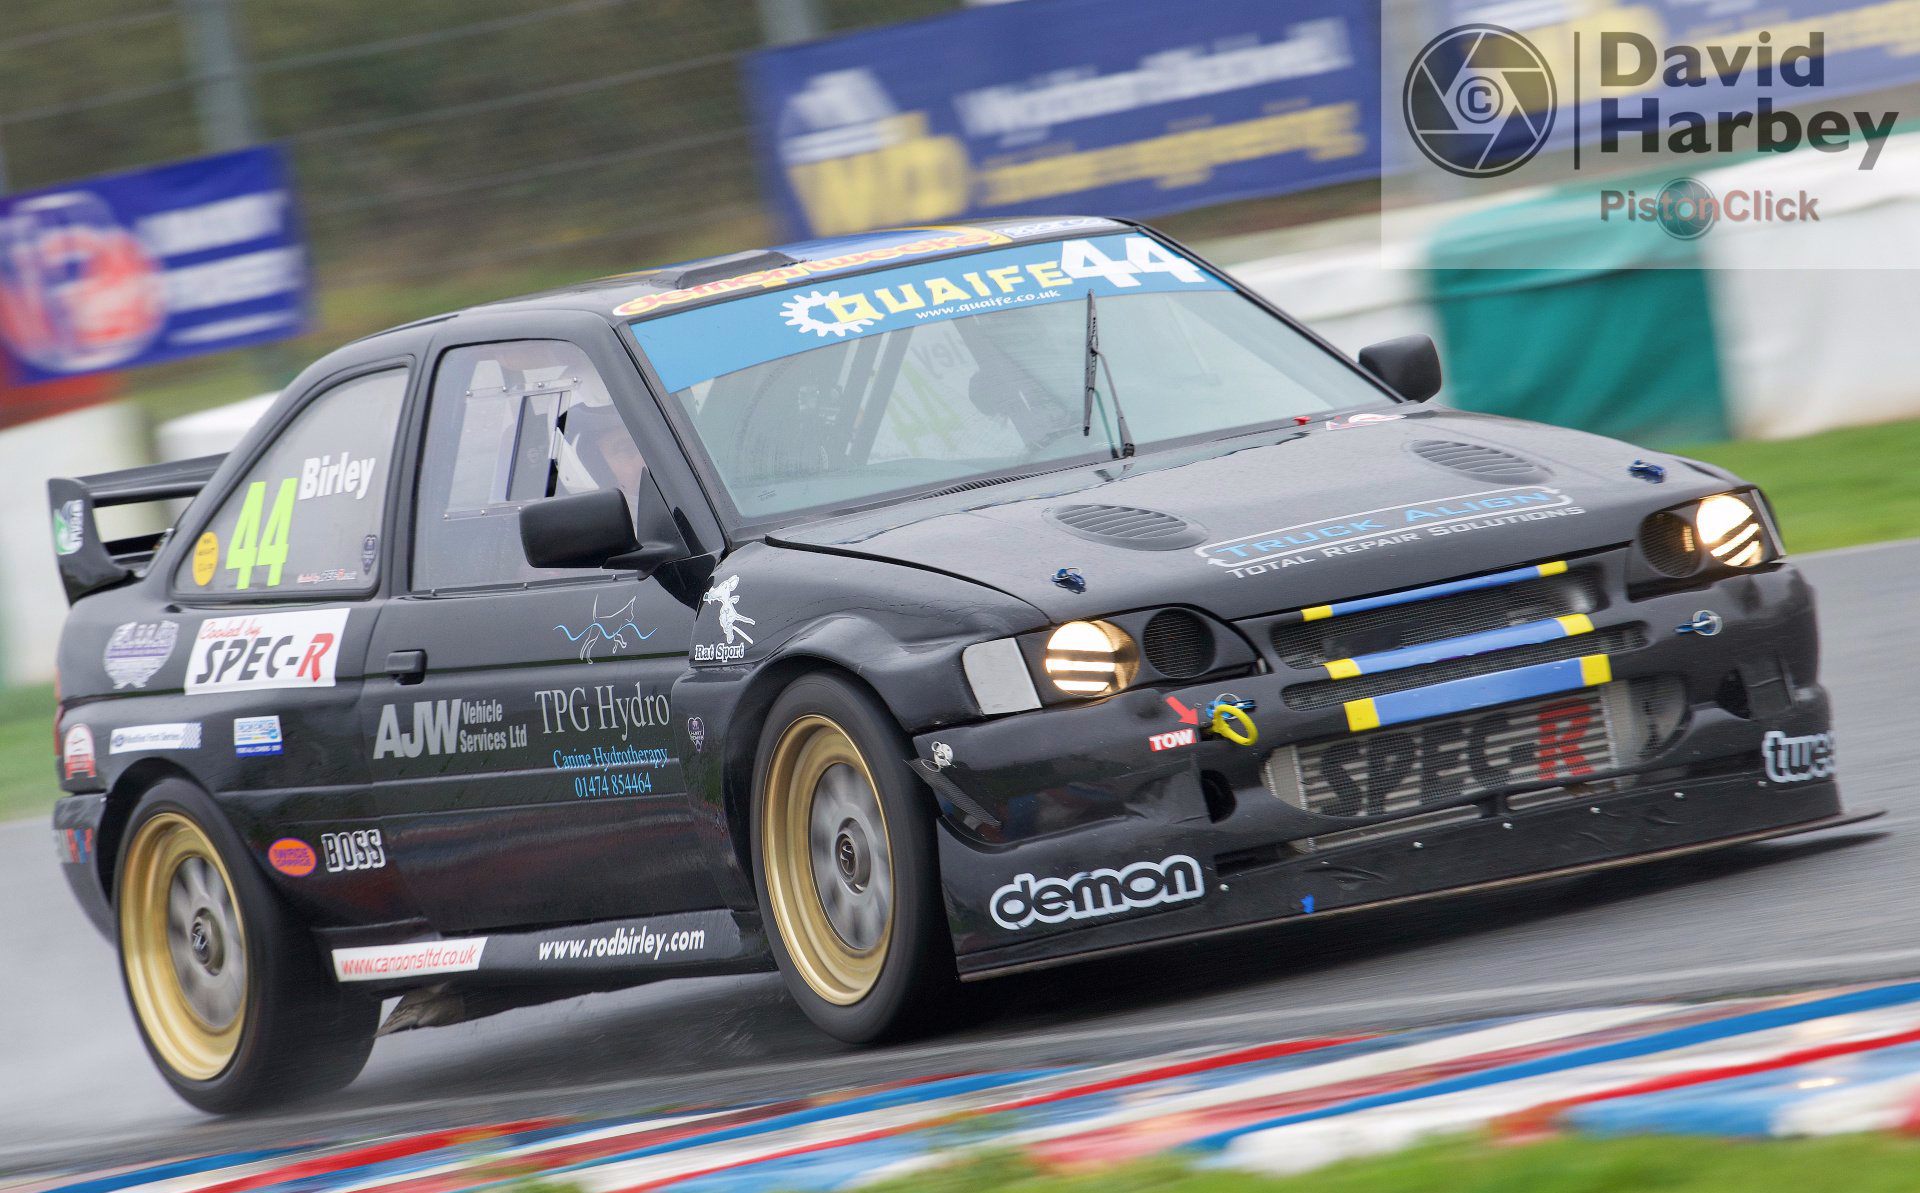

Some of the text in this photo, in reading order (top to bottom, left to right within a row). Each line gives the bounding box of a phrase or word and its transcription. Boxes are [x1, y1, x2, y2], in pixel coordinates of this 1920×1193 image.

[825, 237, 1207, 323] QUAIFE 44
[915, 289, 1061, 319] www.quaife.co.uk
[298, 451, 376, 500] Birley
[225, 477, 299, 590] 44
[1216, 491, 1552, 558] TRUCK ALIGN
[1225, 506, 1586, 579] TOTAL REPAIR SOLUTIONS
[195, 632, 335, 683] SPEC-R
[695, 642, 745, 662] Rat Sport
[373, 699, 462, 759] AJW
[462, 699, 503, 725] Vehicle
[534, 687, 590, 734] TPG
[594, 681, 670, 741] Hydro
[460, 724, 528, 753] Services Ltd
[553, 744, 667, 772] Canine Hydrotherapy
[1151, 730, 1195, 750] TOW
[575, 772, 652, 798] 01474 854464
[321, 829, 386, 872] BOSS
[990, 854, 1205, 930] demon
[539, 926, 705, 961] www.rodbirley.com
